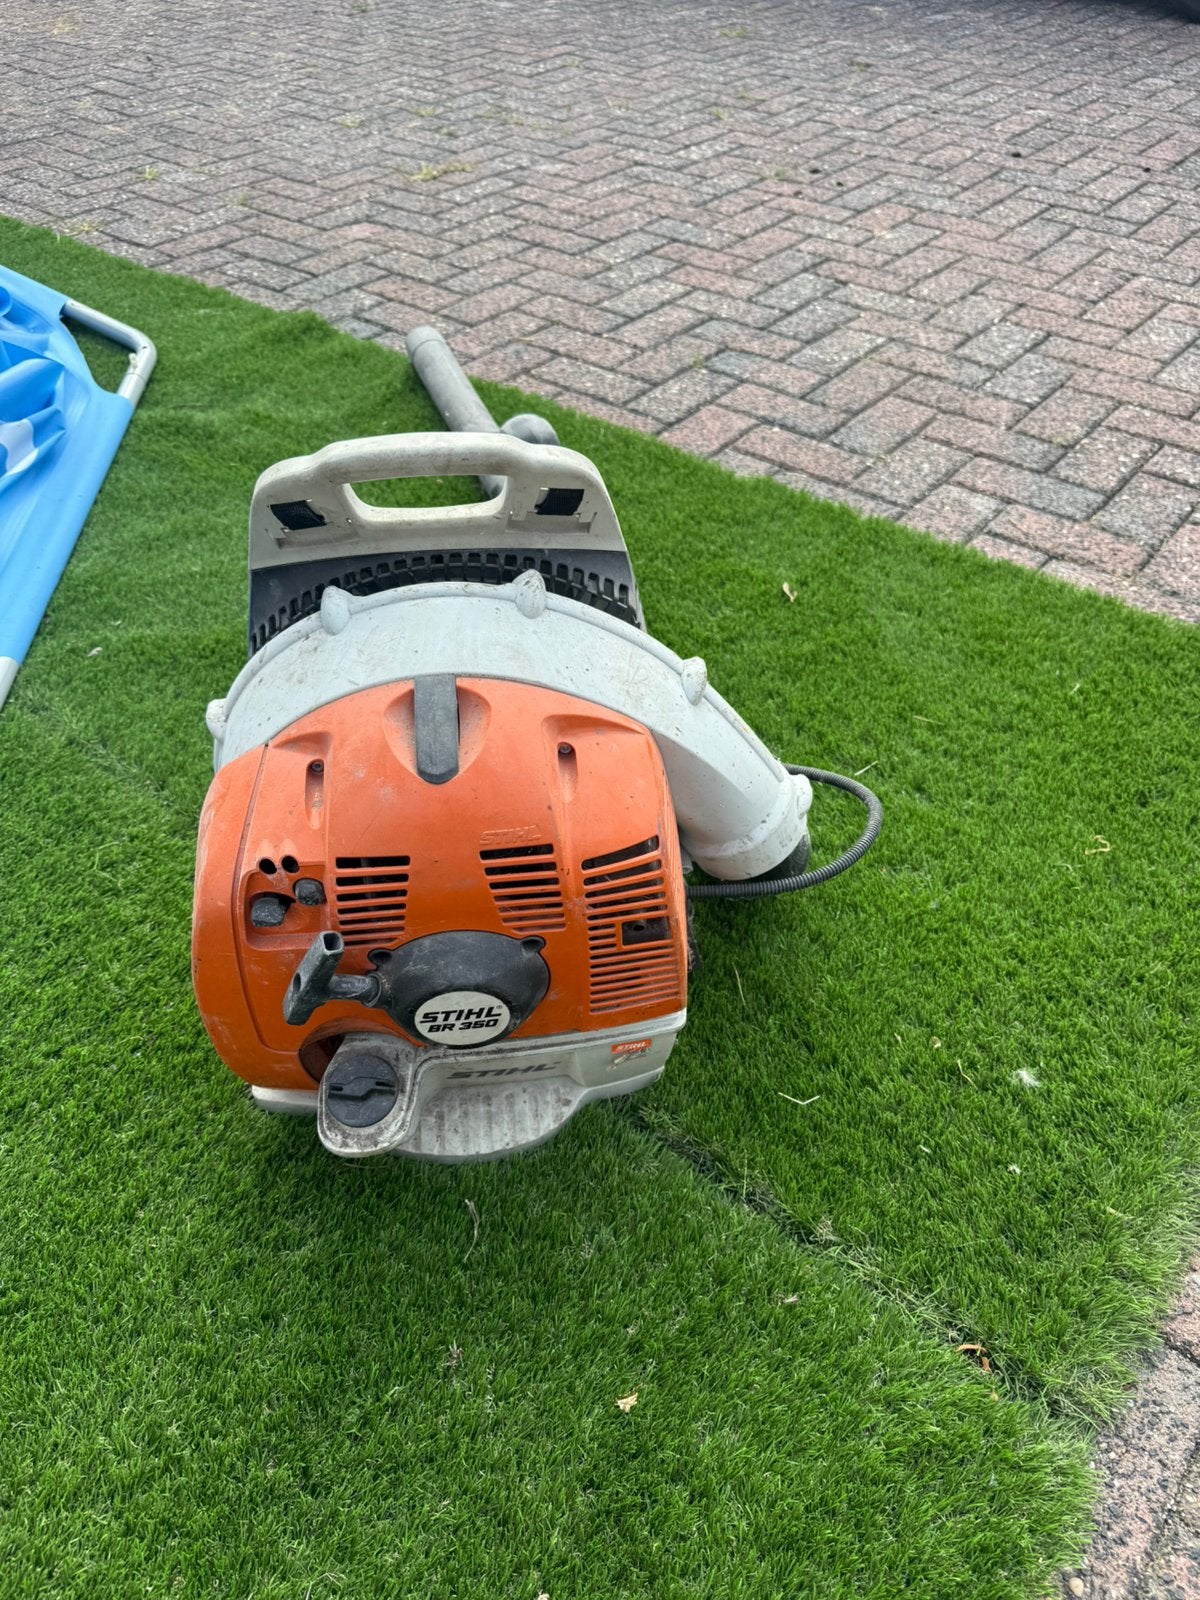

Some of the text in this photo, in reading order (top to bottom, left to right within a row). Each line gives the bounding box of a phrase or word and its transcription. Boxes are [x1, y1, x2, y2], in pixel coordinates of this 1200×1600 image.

[479, 824, 542, 845] STIHL
[419, 1005, 503, 1024] STIHL
[427, 1018, 500, 1033] BR 350
[447, 1063, 557, 1080] STIHL
